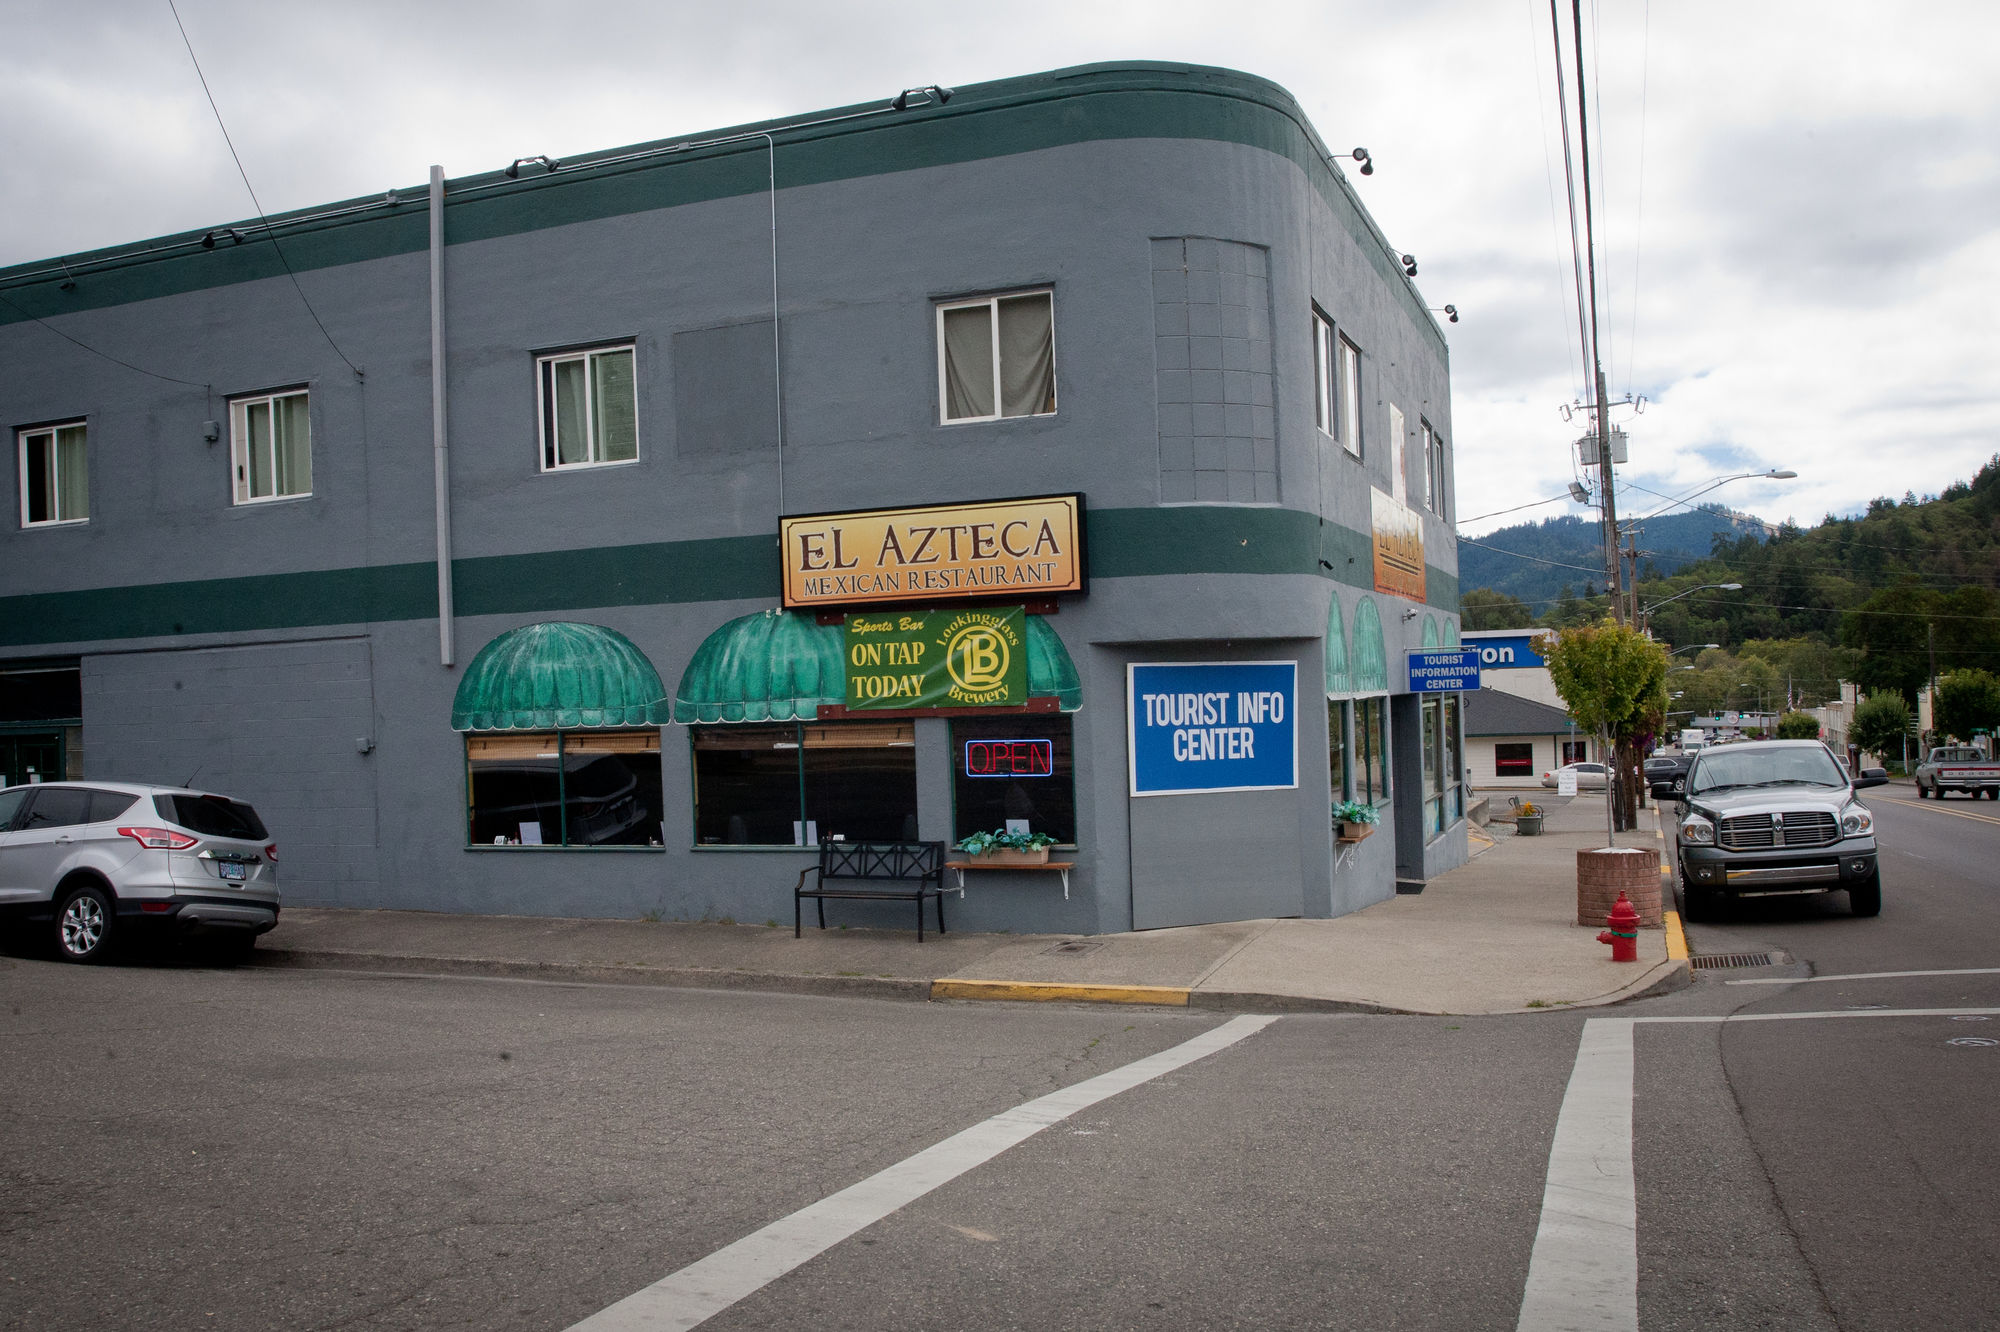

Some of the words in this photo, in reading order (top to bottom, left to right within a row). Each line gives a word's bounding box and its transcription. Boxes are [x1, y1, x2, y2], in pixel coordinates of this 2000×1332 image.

[799, 527, 859, 572] EL
[876, 518, 1061, 567] AZTECA
[804, 572, 900, 597] MEXICAN
[908, 562, 1057, 591] RESTAURANT
[852, 618, 894, 636] Sports
[899, 616, 925, 632] Bar
[936, 612, 1020, 647] Lookingglass
[852, 643, 882, 667] ON
[884, 641, 926, 666] TAP
[1423, 654, 1464, 666] TOURIST
[1411, 666, 1478, 678] INFORMATION
[1426, 678, 1463, 690] CENTER
[852, 674, 926, 699] TODAY
[948, 684, 1009, 704] Brewery
[1142, 692, 1230, 727] TOURIST
[1237, 691, 1285, 725] INFO
[1173, 726, 1255, 763] CENTER
[969, 743, 1050, 774] OPEN
